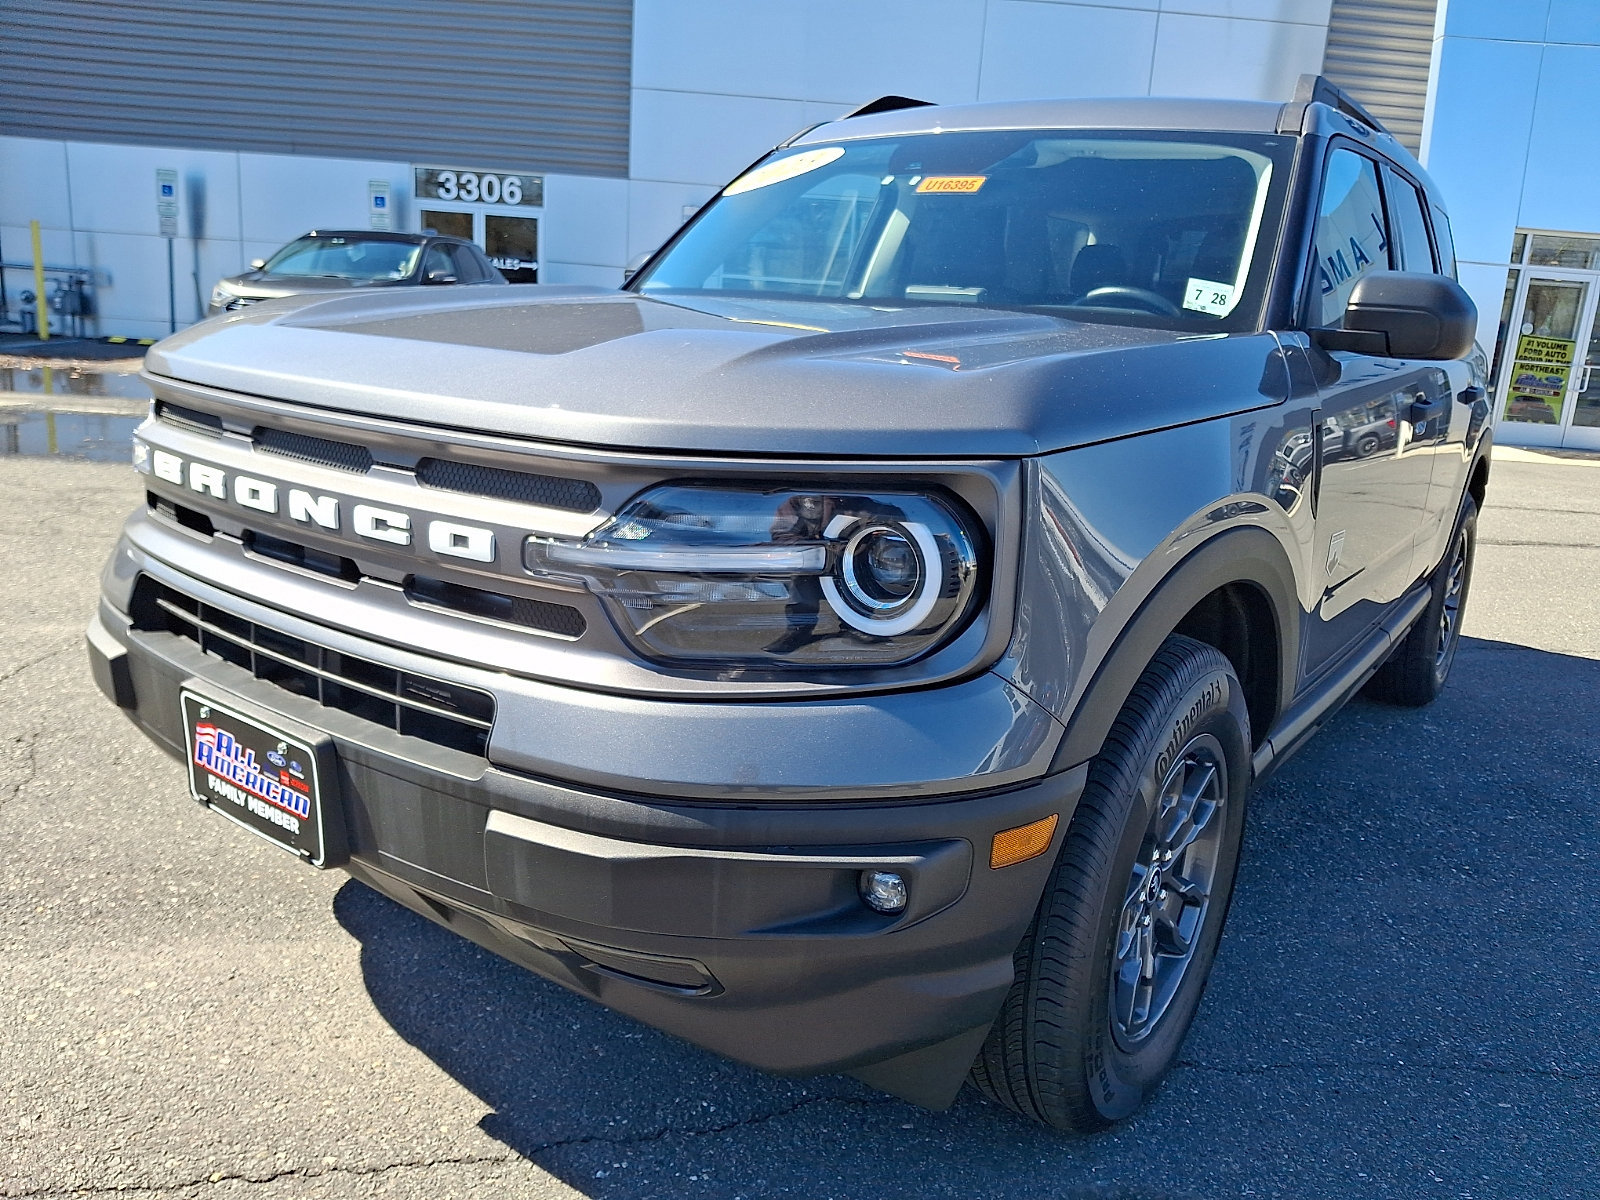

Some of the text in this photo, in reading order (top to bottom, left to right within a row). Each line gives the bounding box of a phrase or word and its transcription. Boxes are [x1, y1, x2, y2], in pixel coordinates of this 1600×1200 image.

[437, 171, 523, 205] 3306
[925, 180, 978, 190] U16395
[489, 257, 521, 270] ALES
[1195, 289, 1203, 300] 7
[1211, 292, 1227, 306] 28
[1524, 348, 1567, 359] FORD AUTO
[1537, 341, 1568, 351] VOLUME
[1520, 363, 1566, 375] NORTHEAST
[153, 450, 496, 563] BRONCO
[1155, 682, 1214, 785] Continental
[208, 774, 301, 835] FAMILY MEMBER
